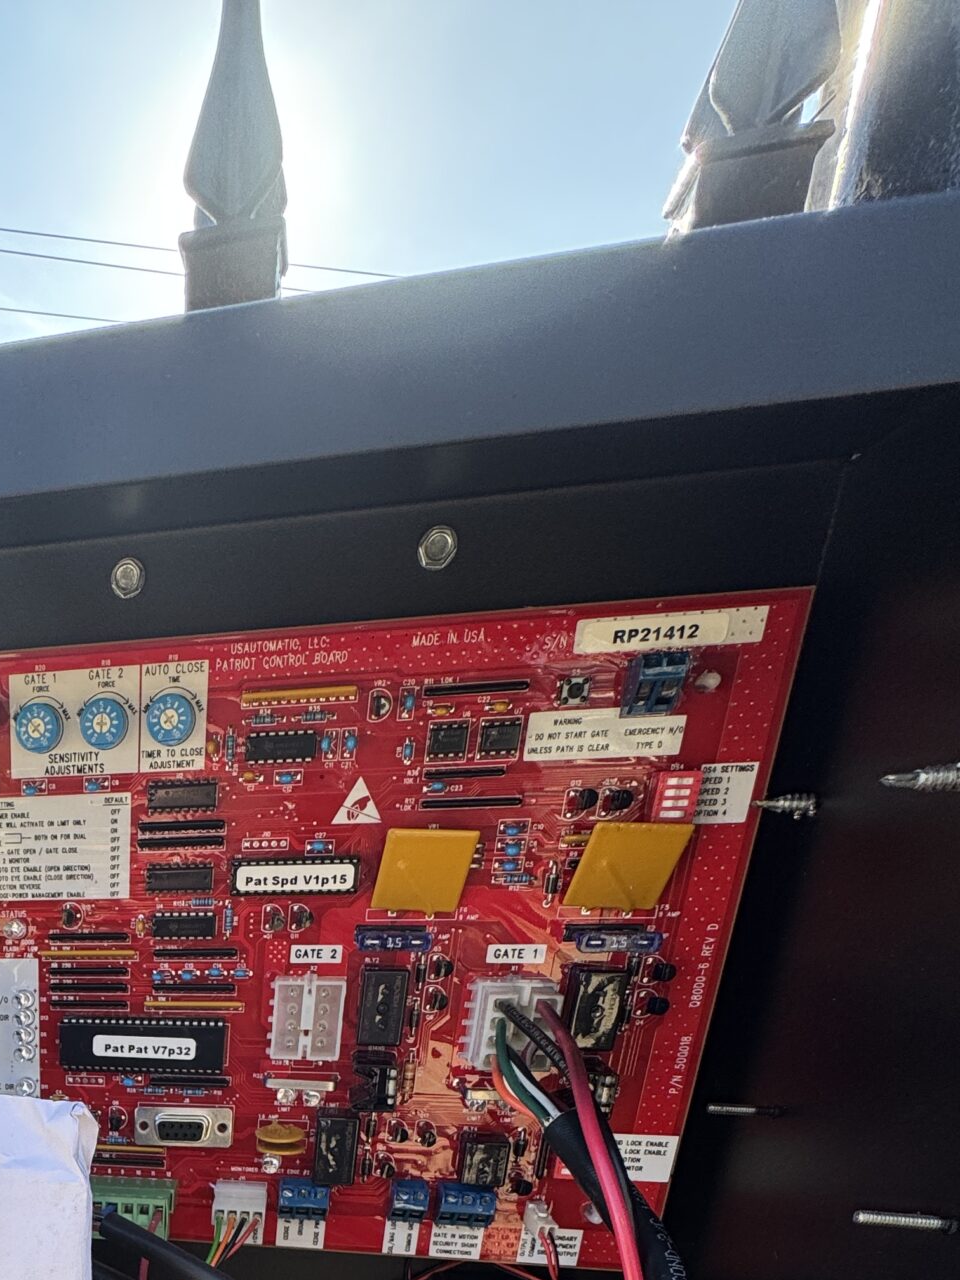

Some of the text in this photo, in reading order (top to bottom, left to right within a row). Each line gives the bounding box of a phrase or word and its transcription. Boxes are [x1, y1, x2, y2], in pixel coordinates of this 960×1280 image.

[413, 628, 485, 646] MADE IN USA
[613, 624, 699, 644] RP21412
[231, 639, 301, 654] USAUTOMATIC,
[543, 636, 567, 649] S/N
[216, 651, 347, 670] PATRIOT CONTROL BOARD
[89, 668, 123, 680] GATE 2
[145, 662, 205, 676] AUTO CLOSE
[24, 673, 56, 684] GATE 1
[196, 700, 204, 713] MAX
[554, 718, 582, 726] WARNING
[535, 730, 609, 741] DO NOT START GATE
[624, 725, 683, 736] EMERGENCY N/O
[528, 743, 609, 754] UNLESS PATH IS CLEAR
[636, 741, 650, 749] TYPE
[48, 751, 100, 763] SENSITIVITY
[142, 747, 203, 759] TIMER TO CLOSE
[45, 763, 105, 776] ADJUSTMENTS
[149, 760, 195, 769] ADJUSTMENT
[701, 776, 730, 785] SPEED 1
[724, 787, 729, 795] 2
[697, 798, 719, 806] SPEED
[693, 809, 719, 817] OPTION
[245, 874, 347, 888] Pat Spd V1p15
[707, 923, 719, 931] D
[295, 949, 337, 959] GATE 2
[494, 947, 537, 959] GATE 1
[701, 935, 715, 961] REV
[104, 1044, 191, 1058] Pat Pat V7p32
[668, 1072, 682, 1095] P/N
